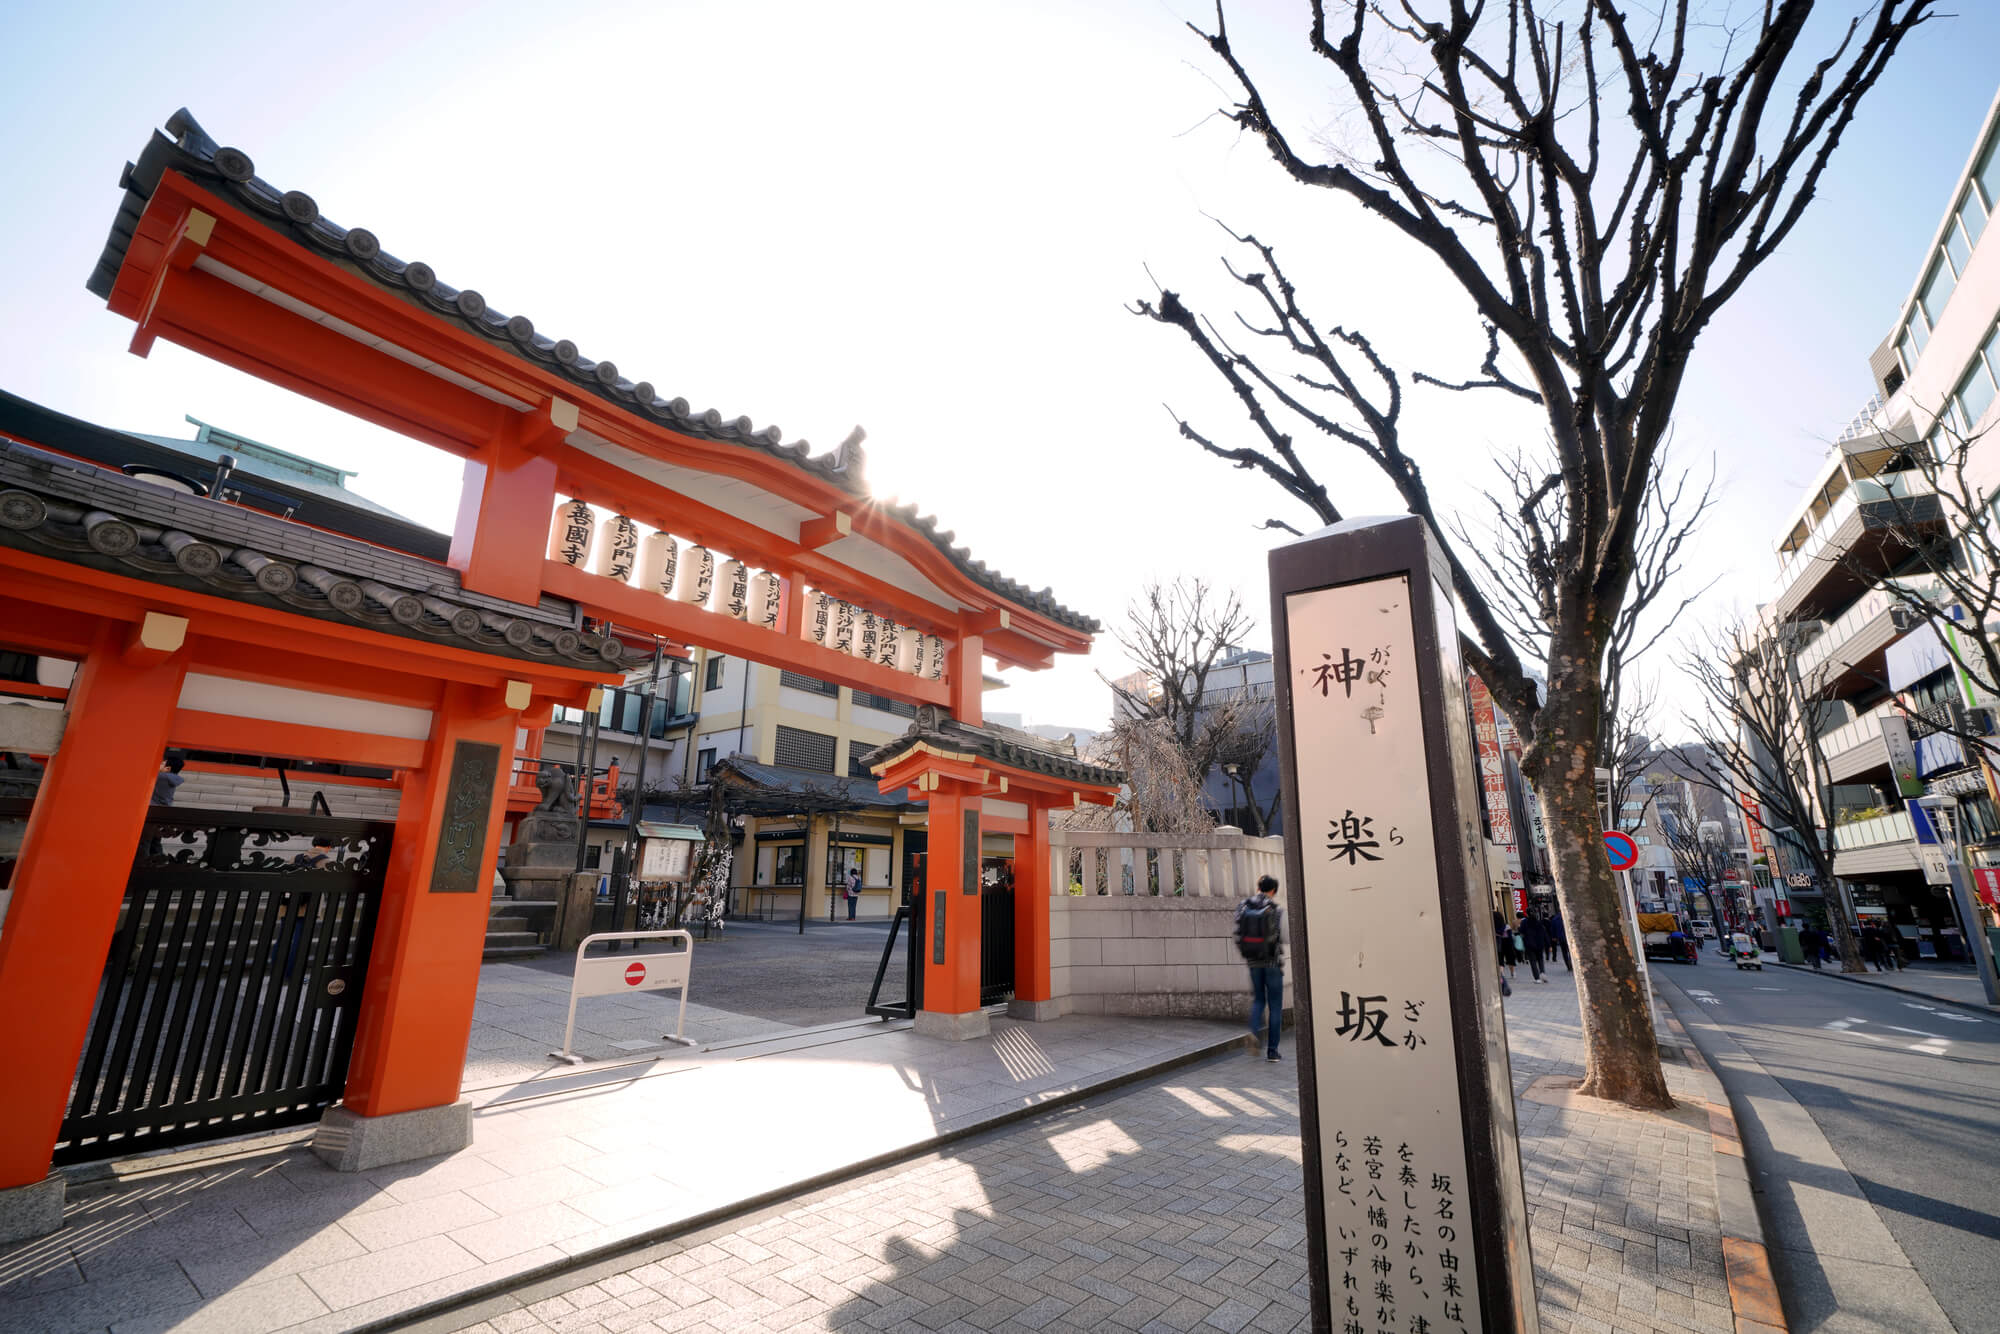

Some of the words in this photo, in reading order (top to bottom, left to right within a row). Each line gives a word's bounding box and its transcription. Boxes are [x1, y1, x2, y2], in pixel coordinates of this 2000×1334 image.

[561, 503, 593, 565] 善國寺
[611, 516, 638, 581] 毘沙門天
[860, 614, 878, 658] 善國寺
[879, 619, 897, 667] 毘沙門天
[1312, 648, 1399, 1047] 神楽坂
[1932, 862, 1945, 873] 13
[1513, 891, 1523, 913] カラオ
[1390, 827, 1404, 846] ら
[1403, 1000, 1427, 1050] ざか
[1335, 1130, 1364, 1334] らなど、いずれも神
[1362, 1136, 1396, 1334] 若宮八幡の神楽が
[1397, 1142, 1432, 1334] を奏したから、津
